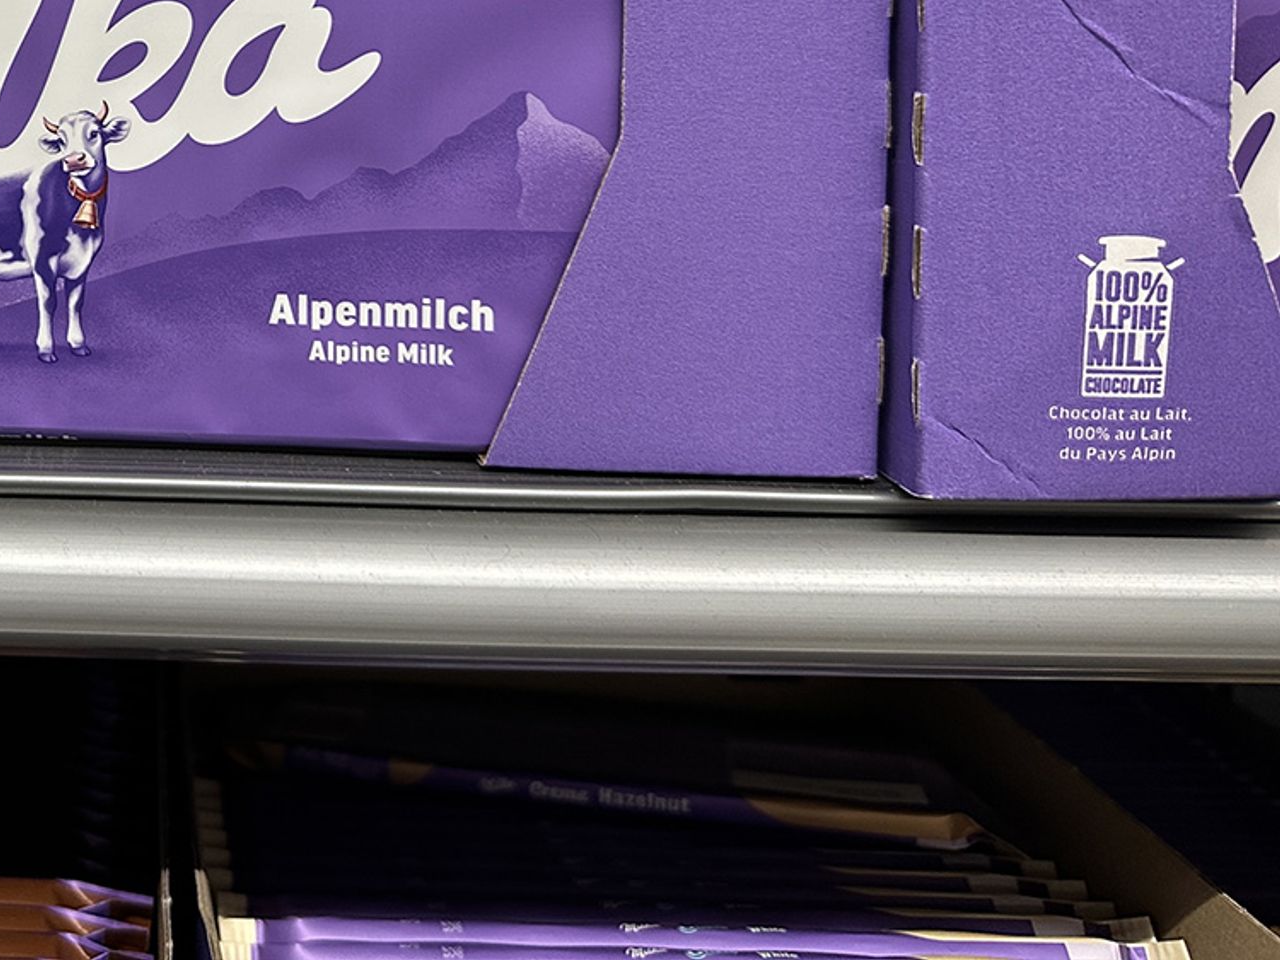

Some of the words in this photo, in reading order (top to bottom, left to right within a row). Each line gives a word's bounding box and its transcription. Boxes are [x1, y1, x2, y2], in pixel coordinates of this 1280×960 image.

[1095, 270, 1168, 303] 100%
[268, 293, 495, 332] Alpenmilch
[1089, 304, 1168, 330] ALPINE
[308, 340, 390, 365] Alpine
[396, 342, 455, 367] Milk
[1086, 331, 1165, 367] MILK
[1084, 376, 1162, 394] CHOCOLATE
[1049, 406, 1125, 420] Chocolat
[1129, 408, 1151, 420] au
[1066, 426, 1110, 440] 100%
[1114, 428, 1136, 440] au
[1140, 426, 1173, 441] Lait
[1059, 447, 1081, 460] du
[1086, 447, 1127, 462] Pays
[1131, 447, 1176, 462] Alpin
[598, 786, 691, 813] Hazelnut
